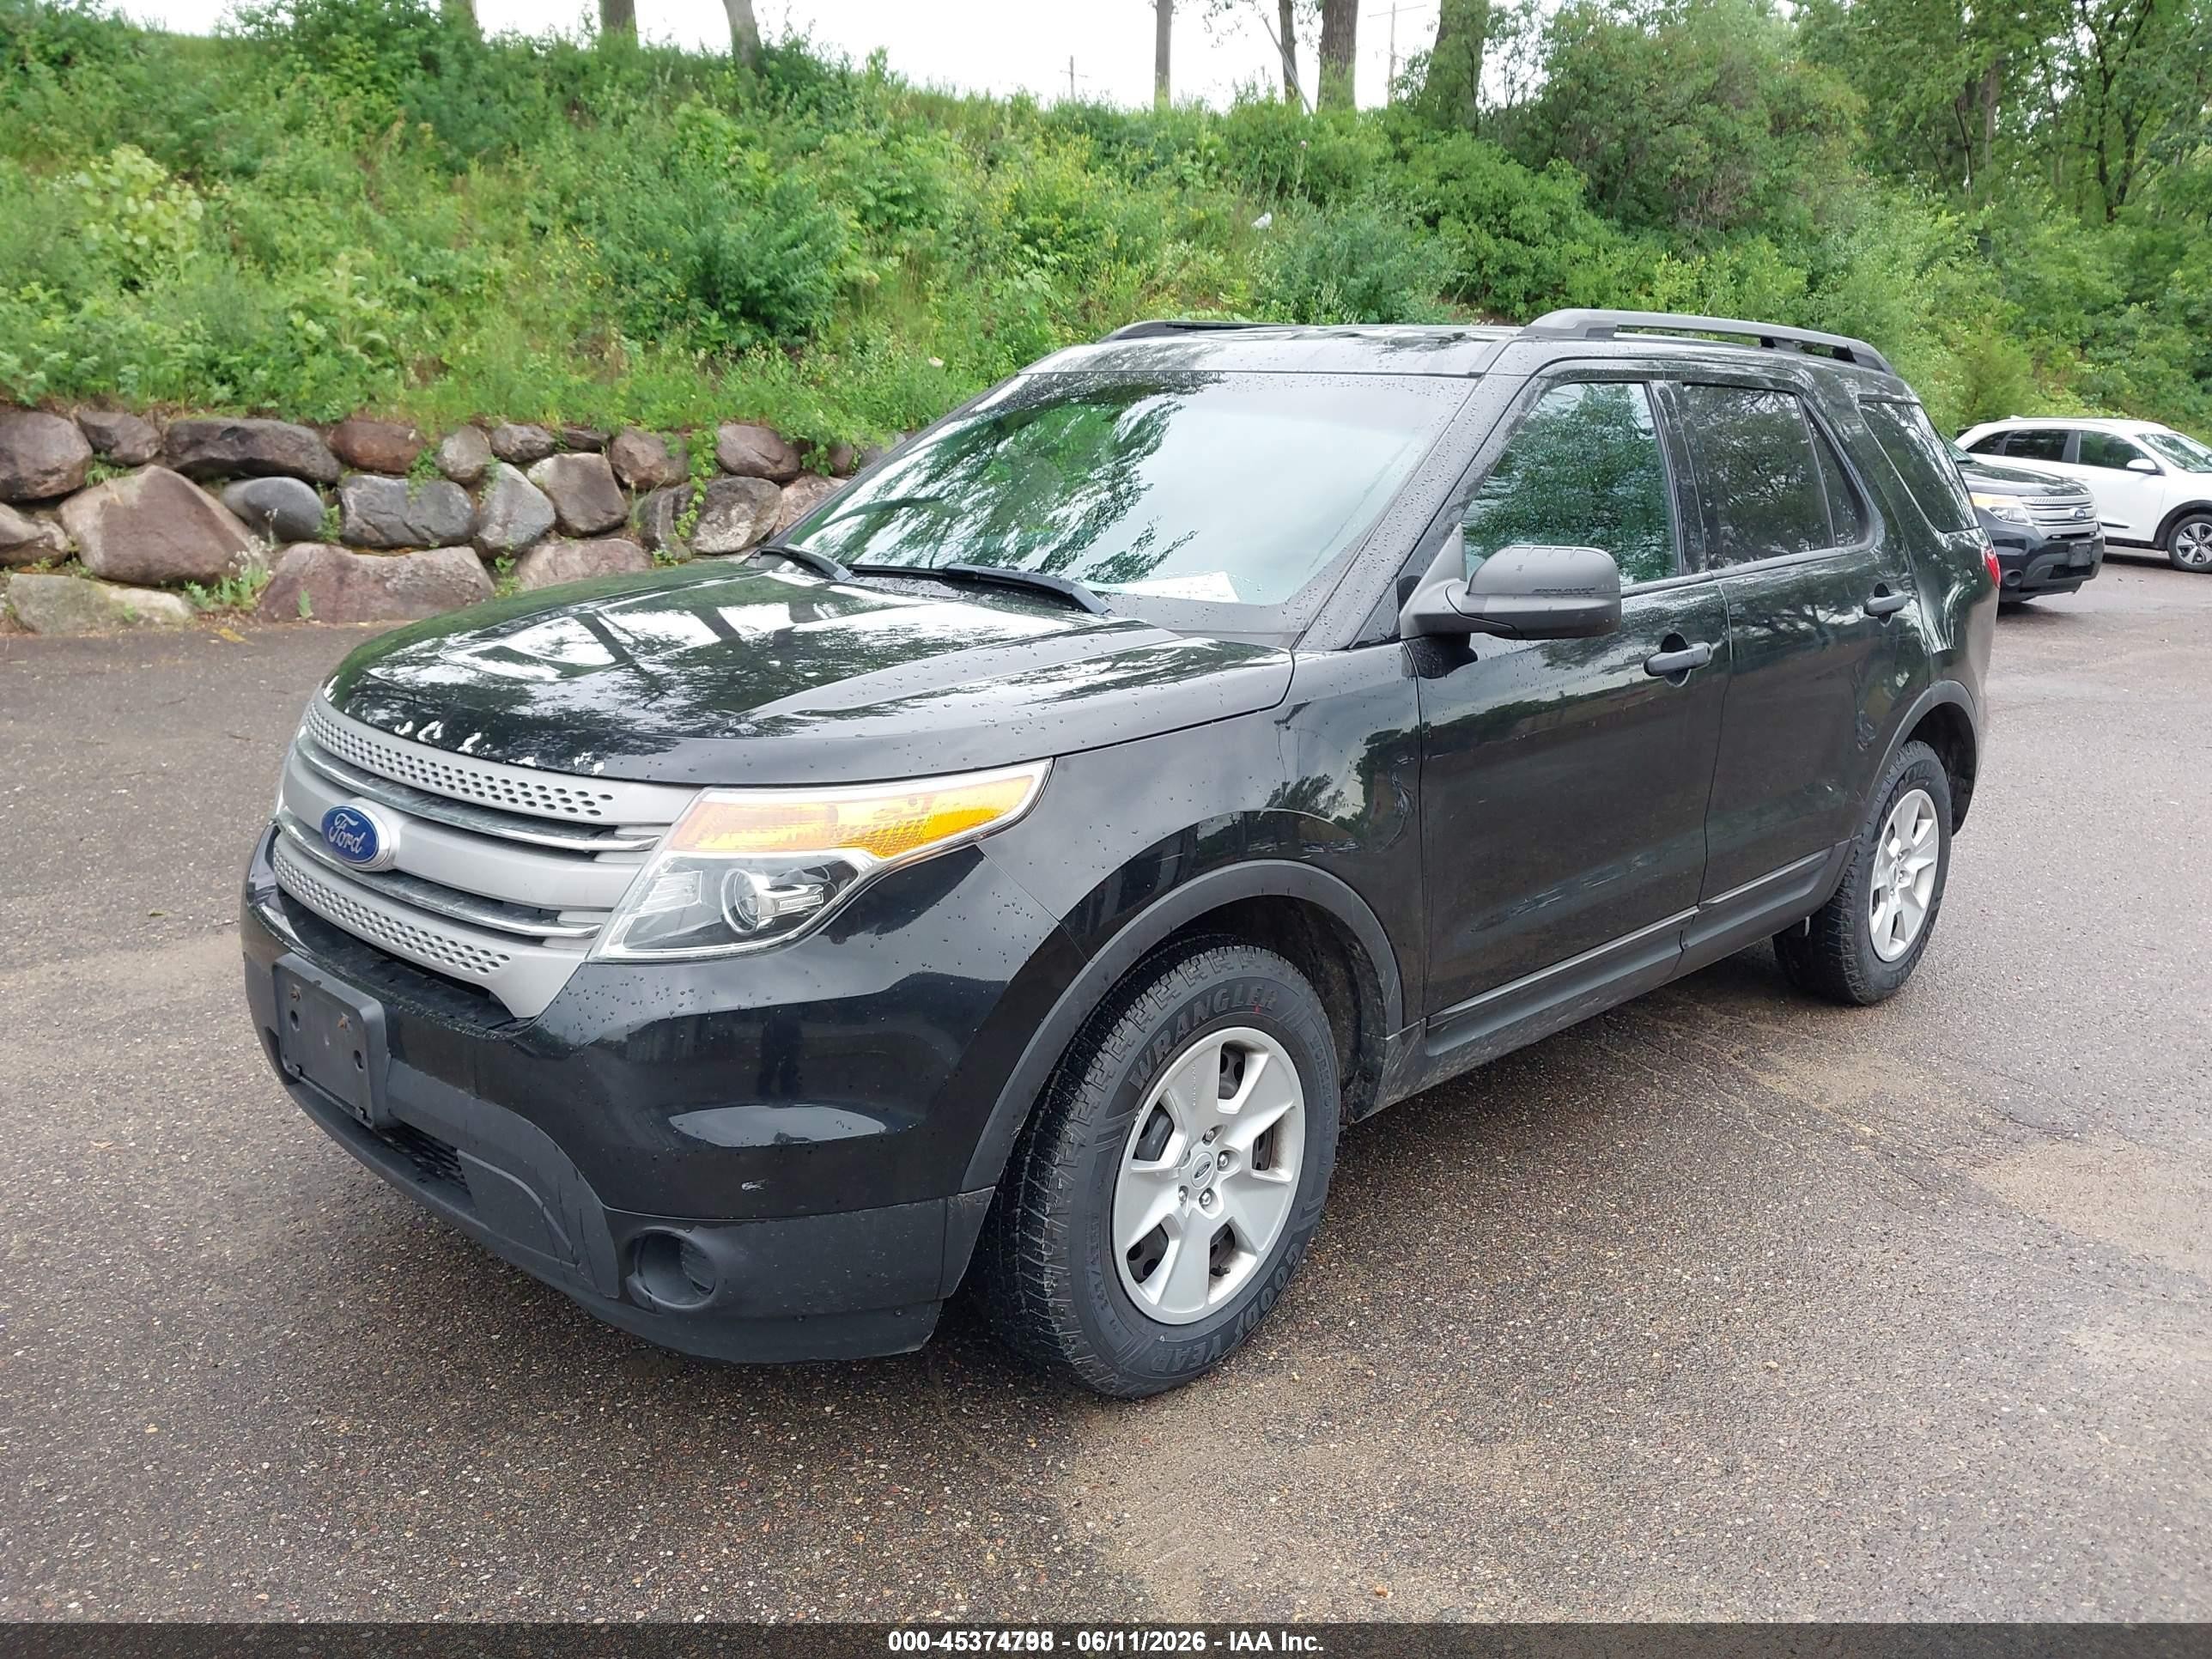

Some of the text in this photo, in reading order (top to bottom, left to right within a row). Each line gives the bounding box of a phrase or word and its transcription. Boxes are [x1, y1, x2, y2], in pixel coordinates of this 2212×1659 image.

[328, 812, 367, 854] Ford
[1128, 983, 1279, 1091] WRANGLER
[1151, 1243, 1303, 1372] GOODYEAR
